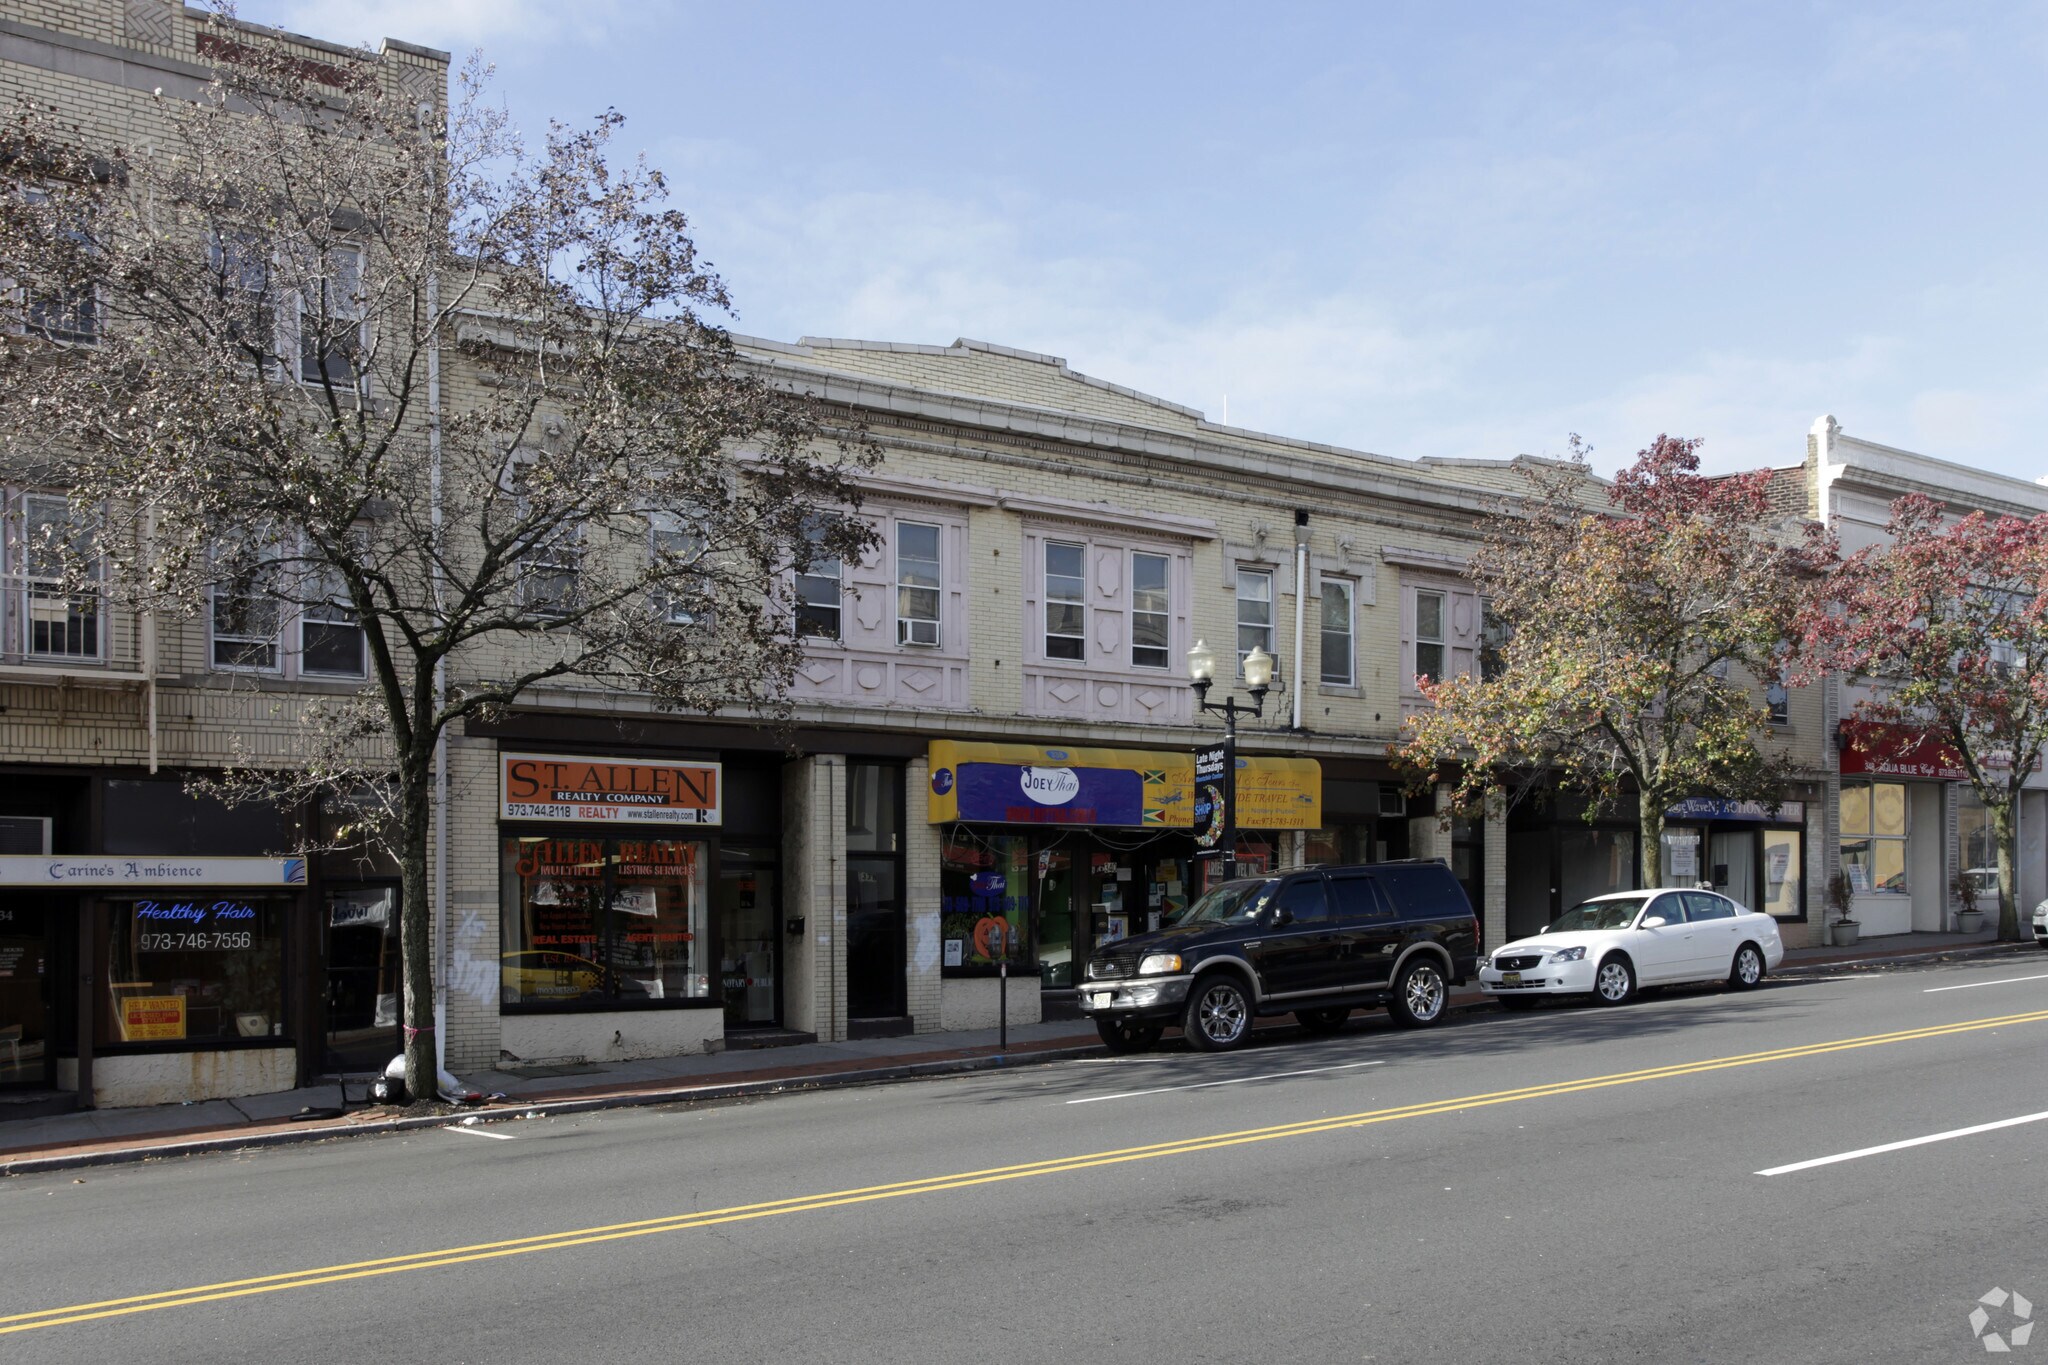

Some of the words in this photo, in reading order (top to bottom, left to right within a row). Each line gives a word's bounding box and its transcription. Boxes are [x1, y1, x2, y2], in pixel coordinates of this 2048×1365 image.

[1196, 753, 1208, 764] Late
[1209, 750, 1224, 763] Night
[1196, 762, 1223, 775] Thursdays
[1899, 764, 1917, 775] BLUE
[578, 765, 712, 804] ALLEN
[1024, 773, 1053, 790] JOEY
[1051, 771, 1079, 793] Thai
[557, 790, 601, 801] REALTY
[607, 793, 665, 804] COMPANY
[1253, 794, 1288, 804] TRAVEL
[508, 804, 572, 818] 973.744.2118
[578, 806, 620, 819] REALTY
[627, 809, 694, 822] www.stallenrealty.com
[1195, 802, 1212, 816] SHOP
[124, 862, 203, 879] Ambience
[541, 864, 602, 877] MULTIPLE
[618, 864, 653, 875] LISTING
[136, 900, 208, 924] Healthy
[211, 900, 257, 920] Hair
[140, 931, 251, 950] 973-746-7556
[533, 934, 560, 945] REAL
[560, 934, 598, 945] ESTATE
